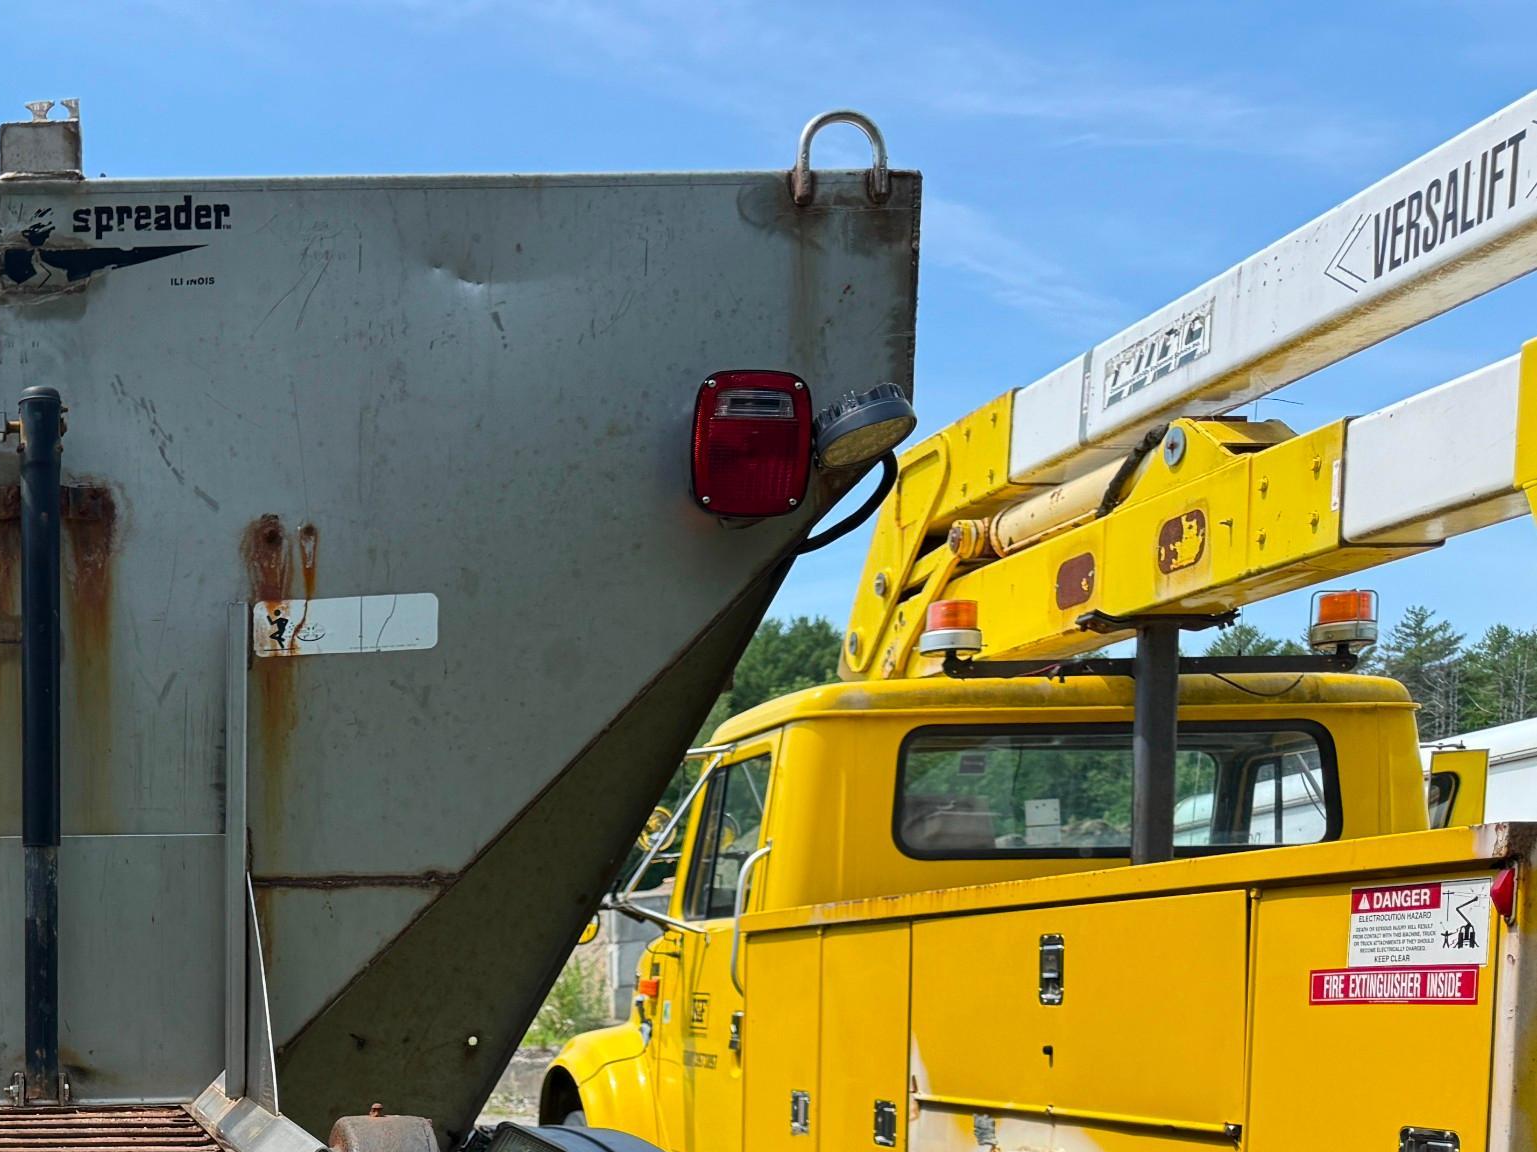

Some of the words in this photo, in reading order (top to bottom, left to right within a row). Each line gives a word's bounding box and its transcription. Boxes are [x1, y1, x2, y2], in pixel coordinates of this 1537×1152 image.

[1373, 128, 1527, 280] VERSALIFT
[72, 194, 231, 240] spreader
[1373, 888, 1431, 909] DANGER
[1358, 913, 1406, 923] ELECTROCUTION
[1406, 911, 1432, 920] HAZARD
[1374, 955, 1390, 963] KEEP
[1390, 954, 1410, 962] CLEAR
[1323, 975, 1345, 999] FIRE
[1348, 973, 1421, 998] EXTINGUISHER
[1426, 972, 1462, 997] INSIDE
